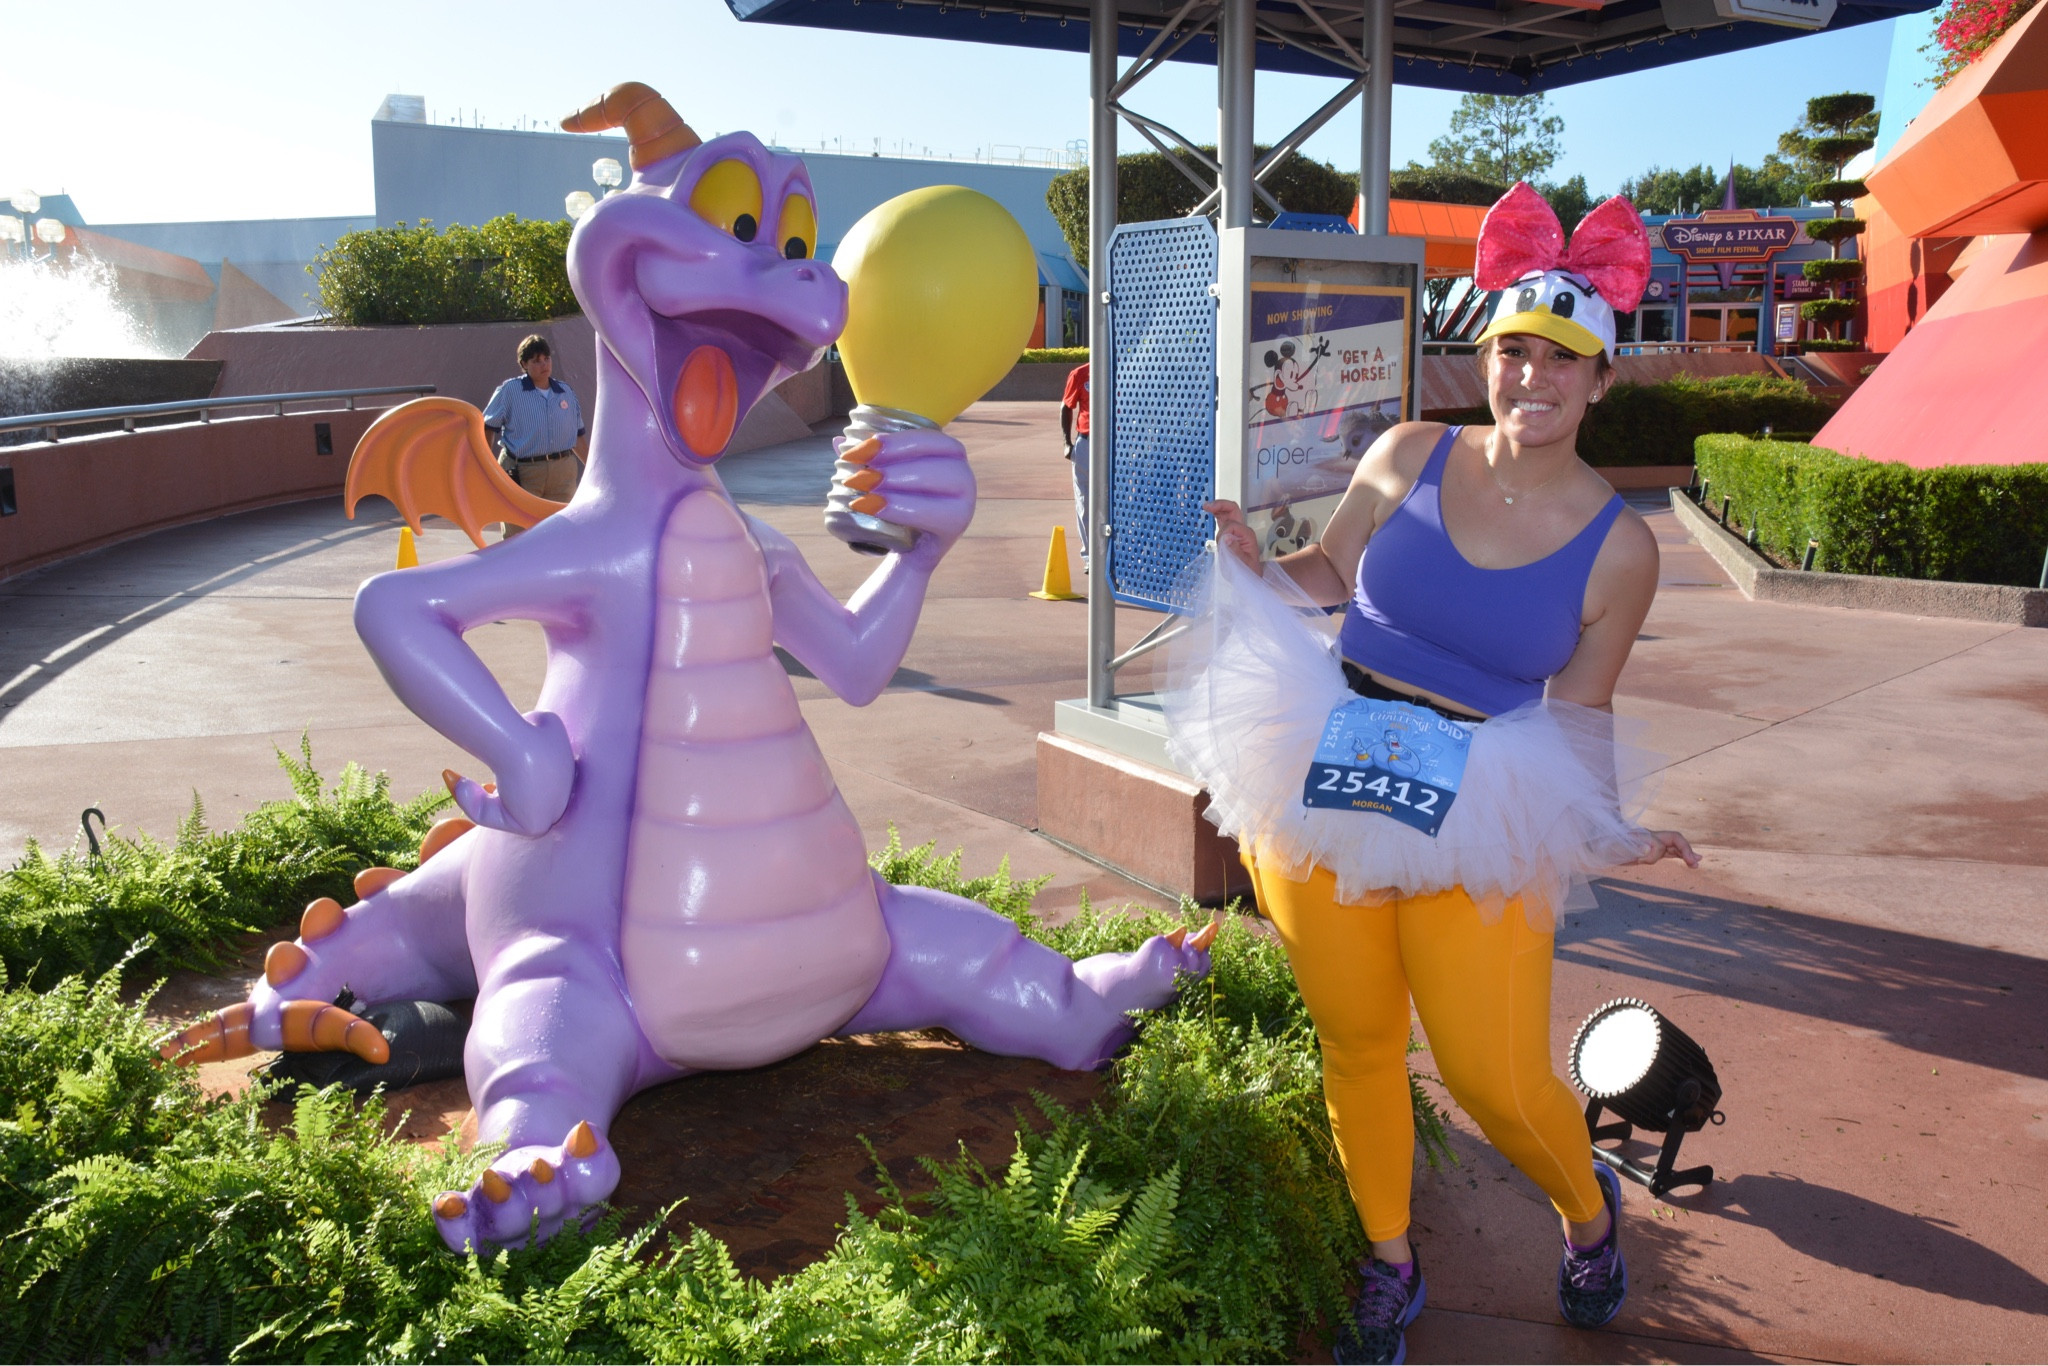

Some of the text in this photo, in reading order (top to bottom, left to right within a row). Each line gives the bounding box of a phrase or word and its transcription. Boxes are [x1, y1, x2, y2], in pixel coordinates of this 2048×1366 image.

[1726, 231, 1734, 241] &
[1738, 228, 1786, 240] PIXAR
[1267, 305, 1333, 325] NOW SHOWING
[1337, 346, 1384, 365] "GET A
[1340, 361, 1397, 384] HORSE!"
[1257, 445, 1314, 480] piper
[1324, 711, 1346, 749] 25412
[1317, 768, 1439, 816] 25412
[1352, 799, 1393, 813] MORGAN
